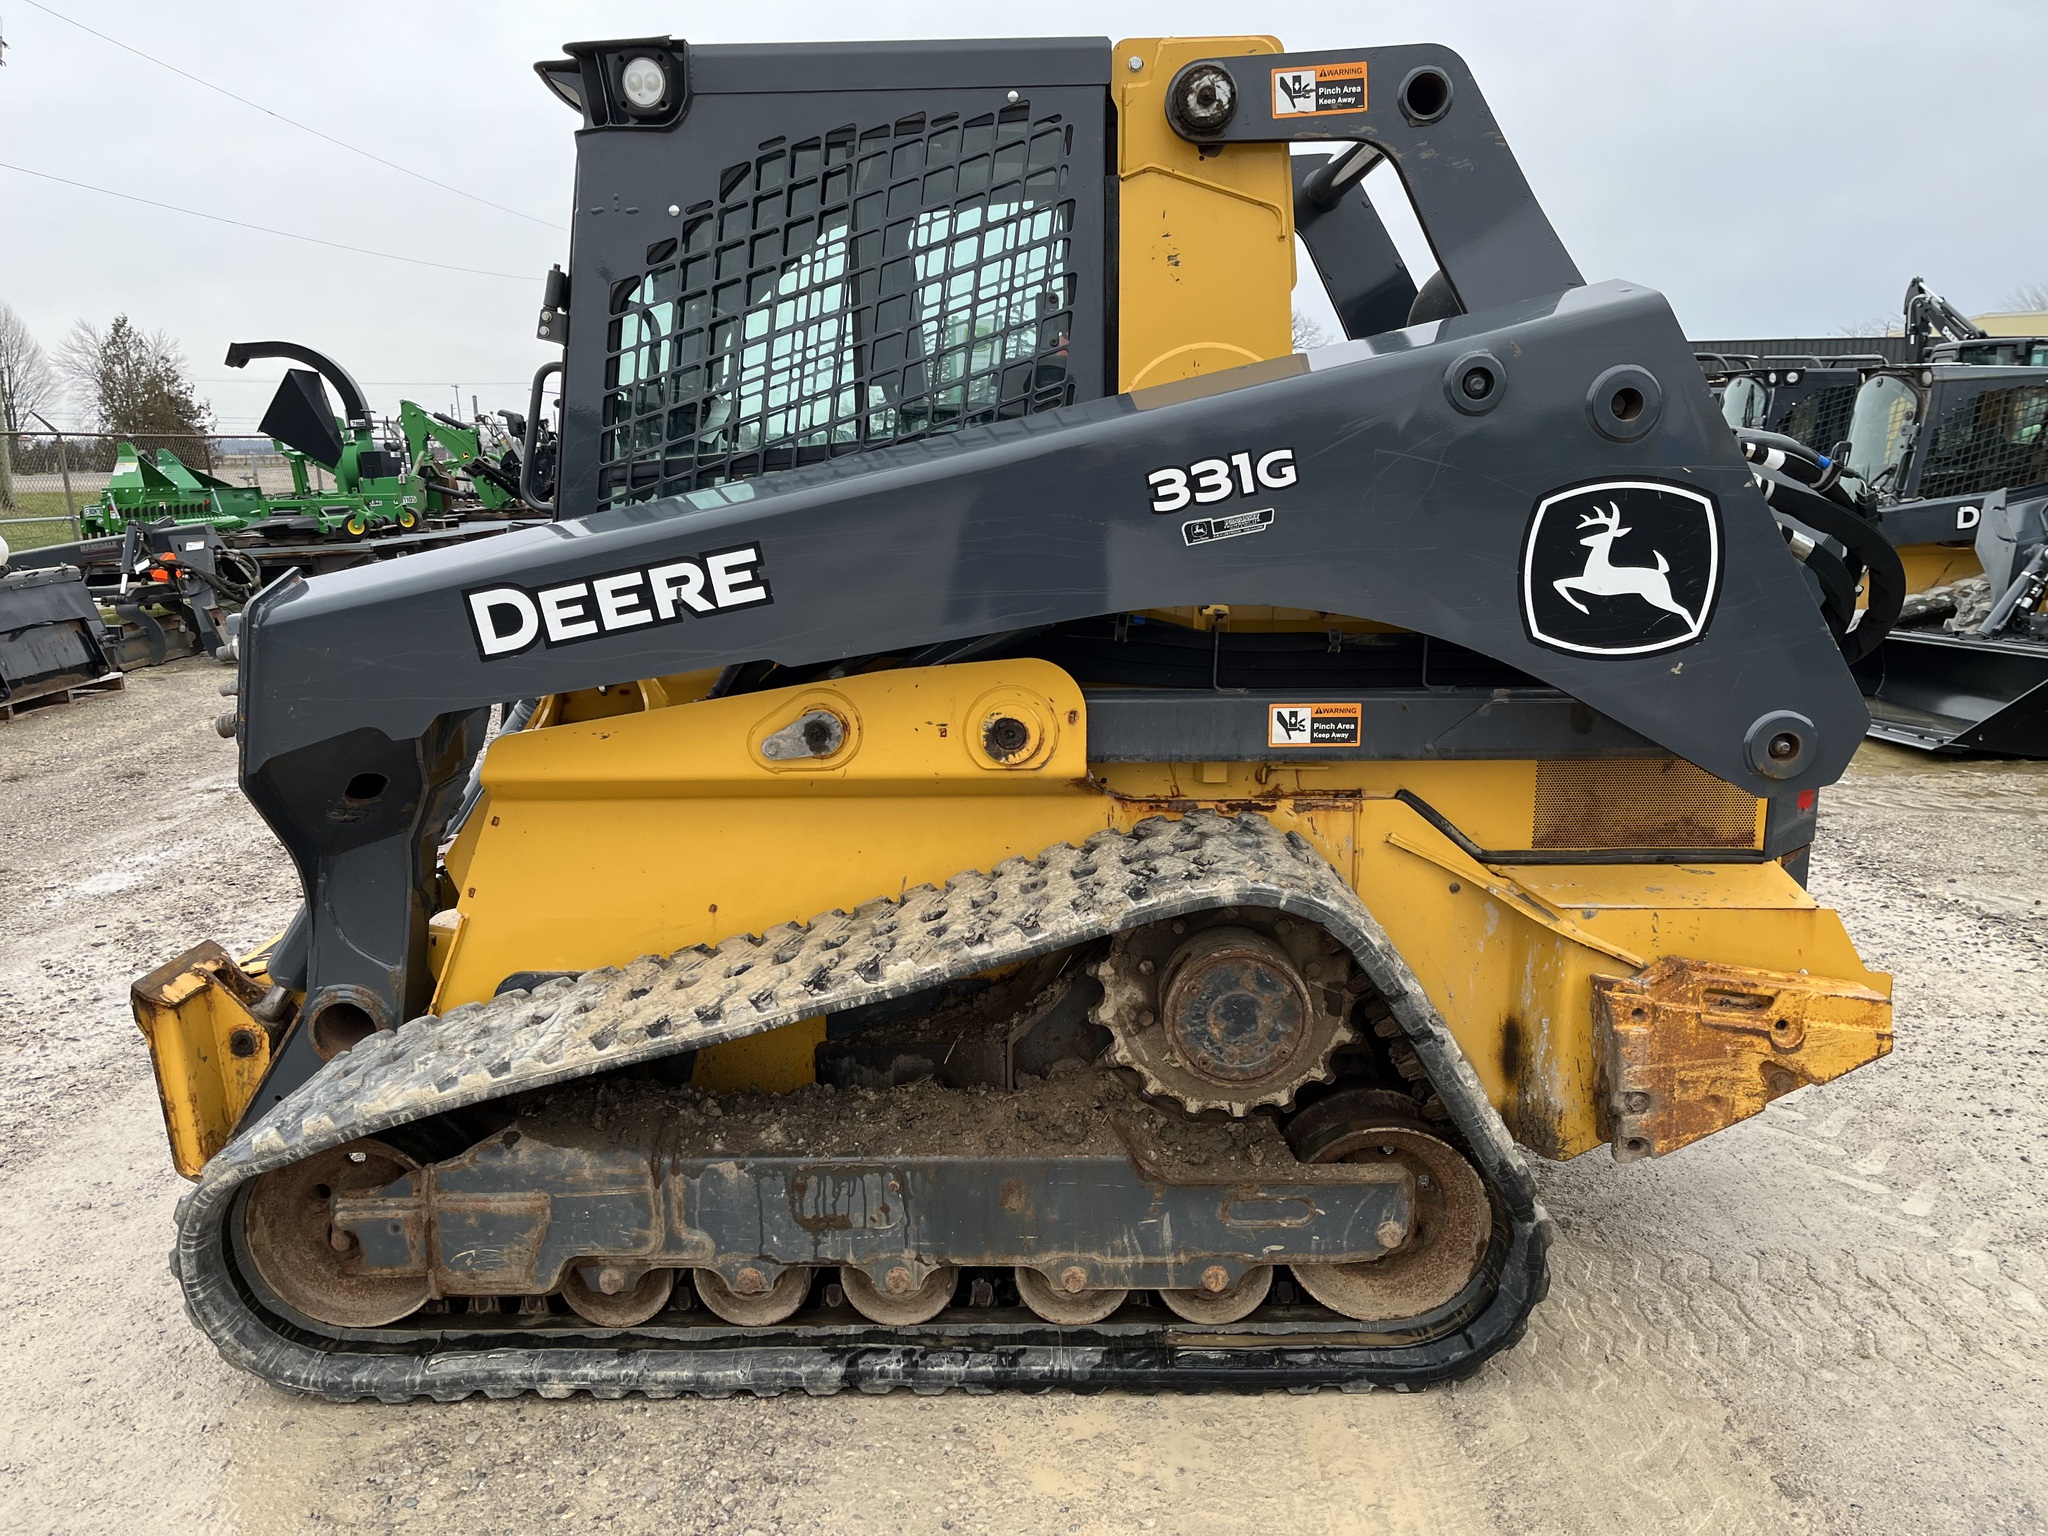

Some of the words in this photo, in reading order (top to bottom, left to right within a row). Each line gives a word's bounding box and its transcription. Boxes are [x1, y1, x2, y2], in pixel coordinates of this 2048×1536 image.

[1327, 68, 1363, 77] WARNING
[1318, 86, 1341, 95] Pinch
[1342, 85, 1361, 94] Area
[1337, 96, 1356, 104] Away
[1148, 449, 1298, 513] 331G
[469, 547, 767, 656] DEERE
[1313, 722, 1336, 730] Pinch
[1337, 722, 1355, 730] Area
